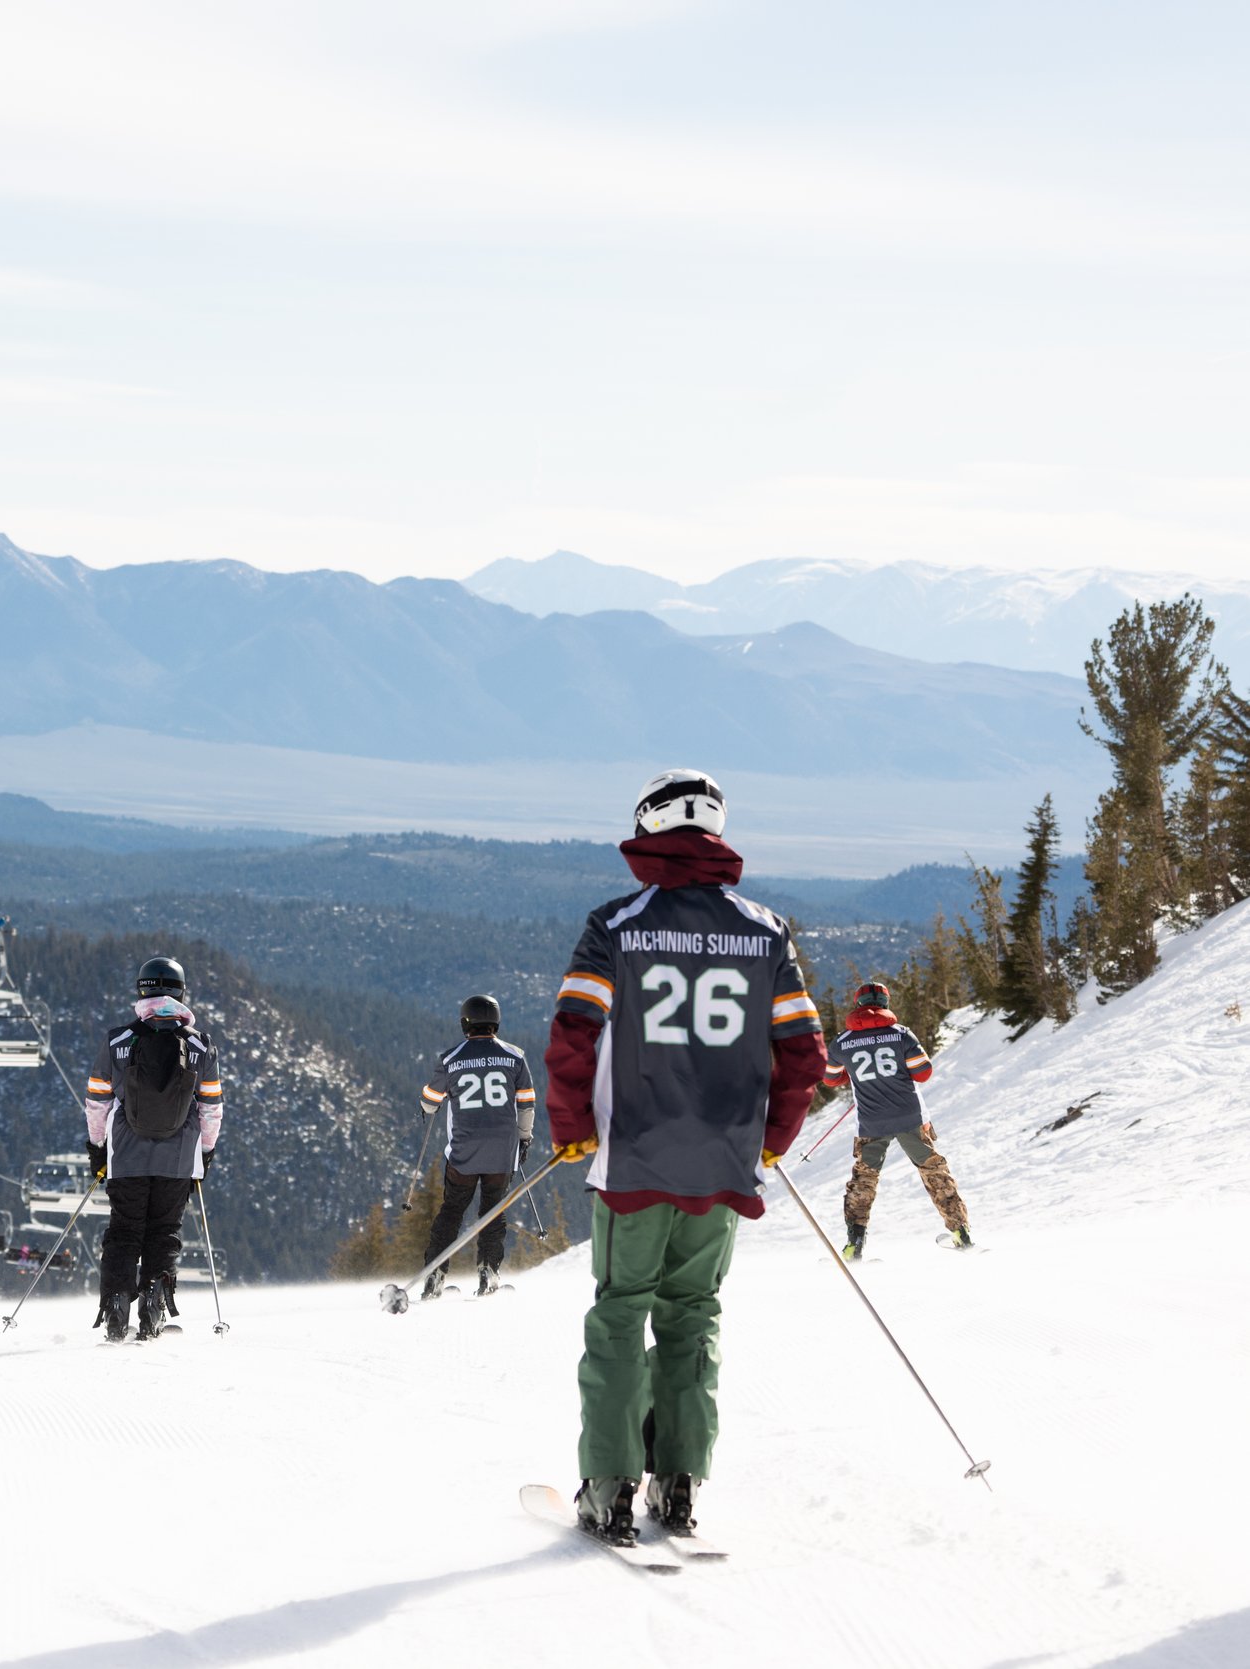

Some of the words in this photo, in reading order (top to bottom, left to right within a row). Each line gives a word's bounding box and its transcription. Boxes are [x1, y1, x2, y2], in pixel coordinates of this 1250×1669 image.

[620, 930, 703, 954] MACHINING
[707, 933, 772, 957] SUMMIT
[641, 964, 749, 1047] 26
[841, 1036, 875, 1051] MACHINING
[876, 1033, 902, 1044] SUMMIT
[447, 1057, 486, 1074] MACHINING
[487, 1056, 516, 1068] SUMMIT
[851, 1047, 898, 1083] 26
[457, 1071, 508, 1110] 26
